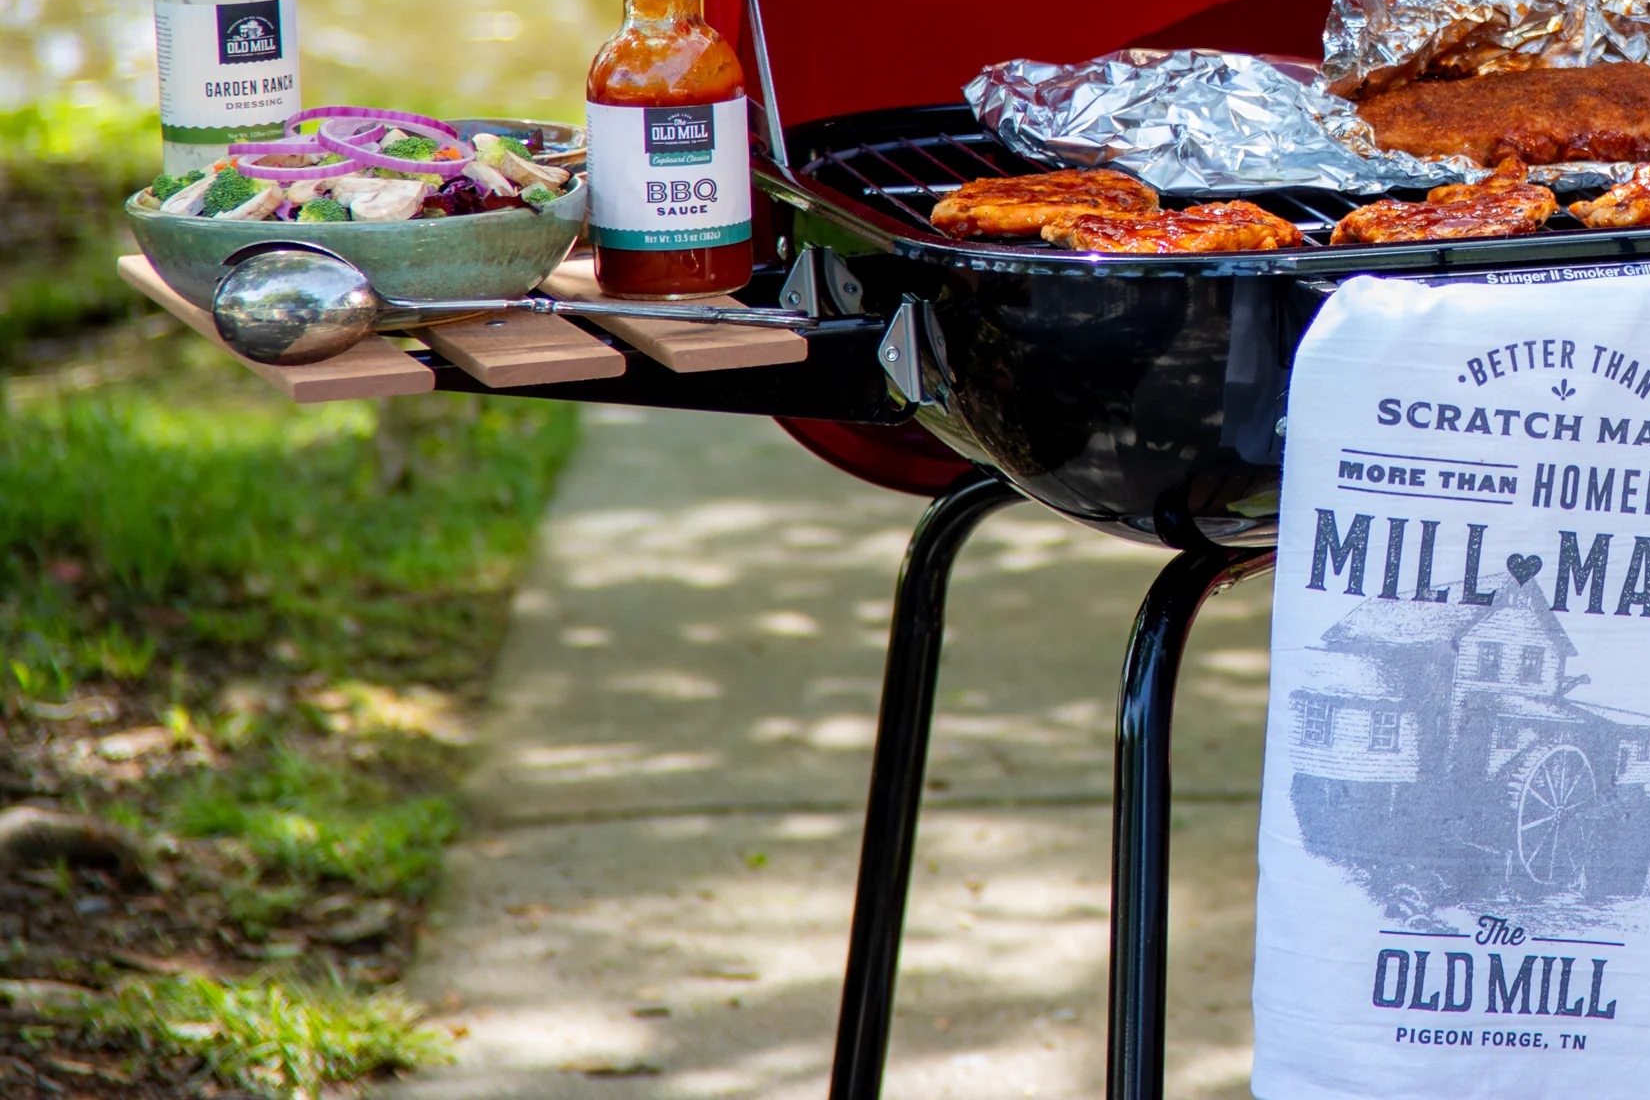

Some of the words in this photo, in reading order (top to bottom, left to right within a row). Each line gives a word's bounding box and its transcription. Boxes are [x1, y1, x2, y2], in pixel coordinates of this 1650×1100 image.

[226, 41, 249, 54] OLD
[250, 38, 276, 52] MILL
[205, 80, 257, 97] GARDEN
[262, 73, 293, 94] RANCH
[226, 98, 283, 110] DRESSING
[652, 126, 676, 140] OLD
[678, 124, 708, 140] MILL
[686, 154, 710, 163] Classics
[646, 178, 718, 203] BBQ
[657, 204, 708, 216] SAUCE
[674, 234, 688, 243] 13.5
[1549, 270, 1560, 280] II
[1563, 266, 1620, 280] Smoker
[1467, 339, 1576, 387] BETTER
[1377, 398, 1584, 442] SCRATCH
[1338, 460, 1426, 487] MORE
[1439, 471, 1518, 494] THAN
[1305, 508, 1496, 607] MILL
[1475, 915, 1526, 946] The
[1372, 948, 1474, 1013] OLD
[1484, 953, 1617, 1020] MILL
[1396, 1027, 1473, 1046] PIGEON
[1481, 1031, 1549, 1050] FORGE,
[1560, 1034, 1587, 1050] TN
